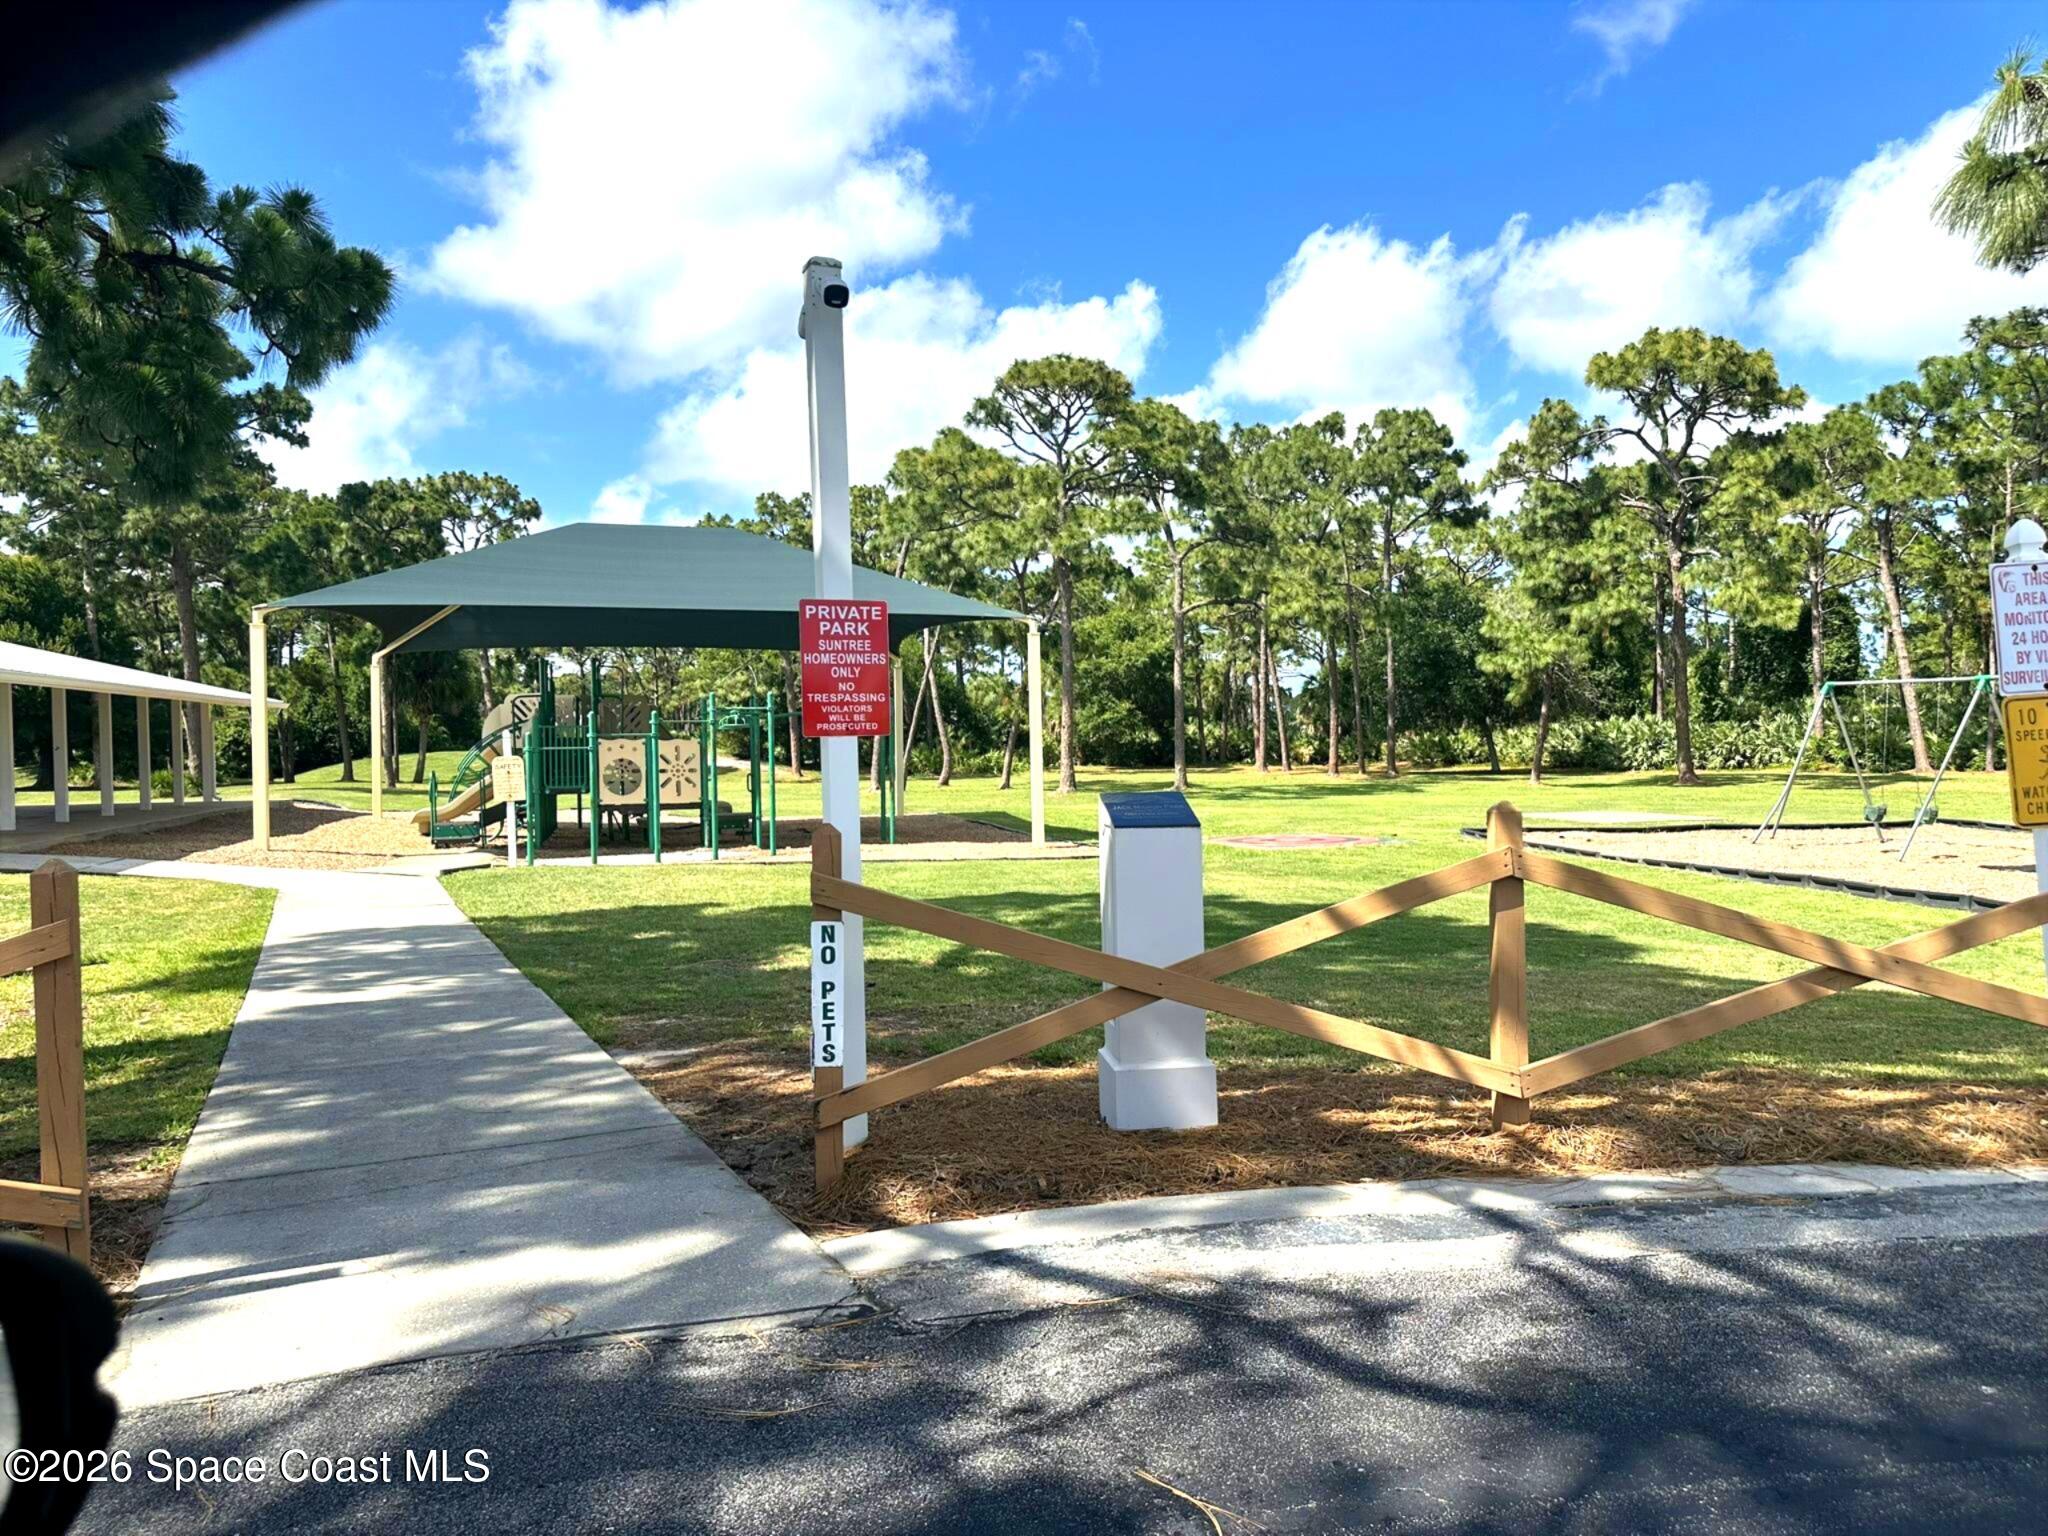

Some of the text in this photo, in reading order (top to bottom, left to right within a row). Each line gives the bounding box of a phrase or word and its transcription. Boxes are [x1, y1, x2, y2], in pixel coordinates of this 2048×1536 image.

[2022, 571, 2048, 586] THIS
[2015, 591, 2048, 606] AREA
[805, 605, 882, 620] PRIVATE
[819, 621, 870, 636] PARK
[2011, 631, 2027, 645] 24
[818, 639, 872, 651] SUNTREE
[804, 653, 886, 665] HOMEOWNERS
[2016, 650, 2031, 664] BY
[831, 666, 861, 678] ONLY
[838, 682, 855, 691] NO
[807, 693, 886, 702] TRESPASSING
[821, 704, 873, 713] VIOLATORS
[853, 713, 866, 721] BE
[2018, 707, 2037, 726] 10
[816, 722, 878, 731] PROSECUTED
[820, 925, 836, 1063] NO PETS
